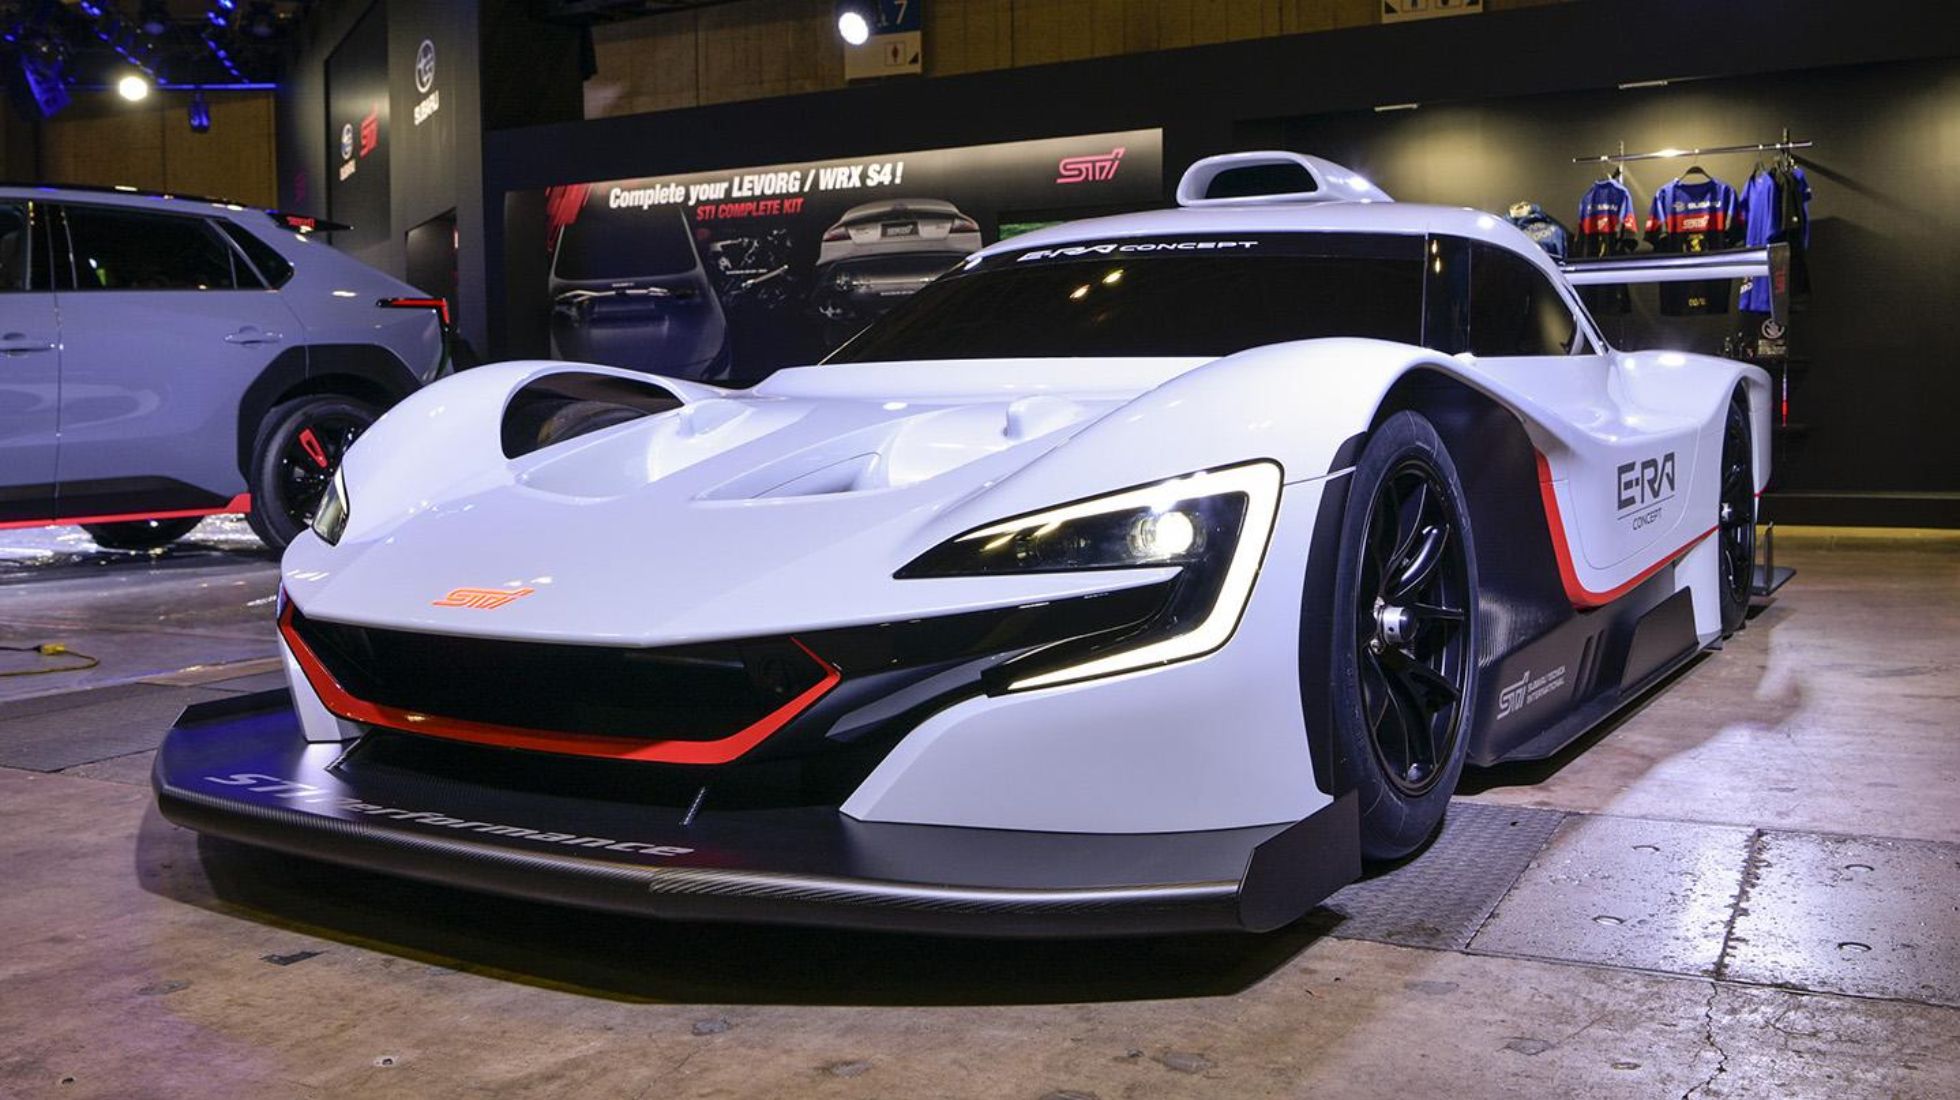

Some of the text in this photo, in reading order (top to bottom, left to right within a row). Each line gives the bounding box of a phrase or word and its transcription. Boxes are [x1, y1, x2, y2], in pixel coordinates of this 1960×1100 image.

[609, 183, 685, 210] Complete
[688, 181, 729, 206] your
[731, 168, 801, 198] LEVORG
[803, 169, 816, 192] /
[819, 165, 863, 191] WRX
[696, 197, 804, 221] STI COMPLETE KIT
[1118, 241, 1259, 252] CONCEPT
[1617, 451, 1675, 511] E-RA
[1632, 507, 1662, 531] CONCEPT
